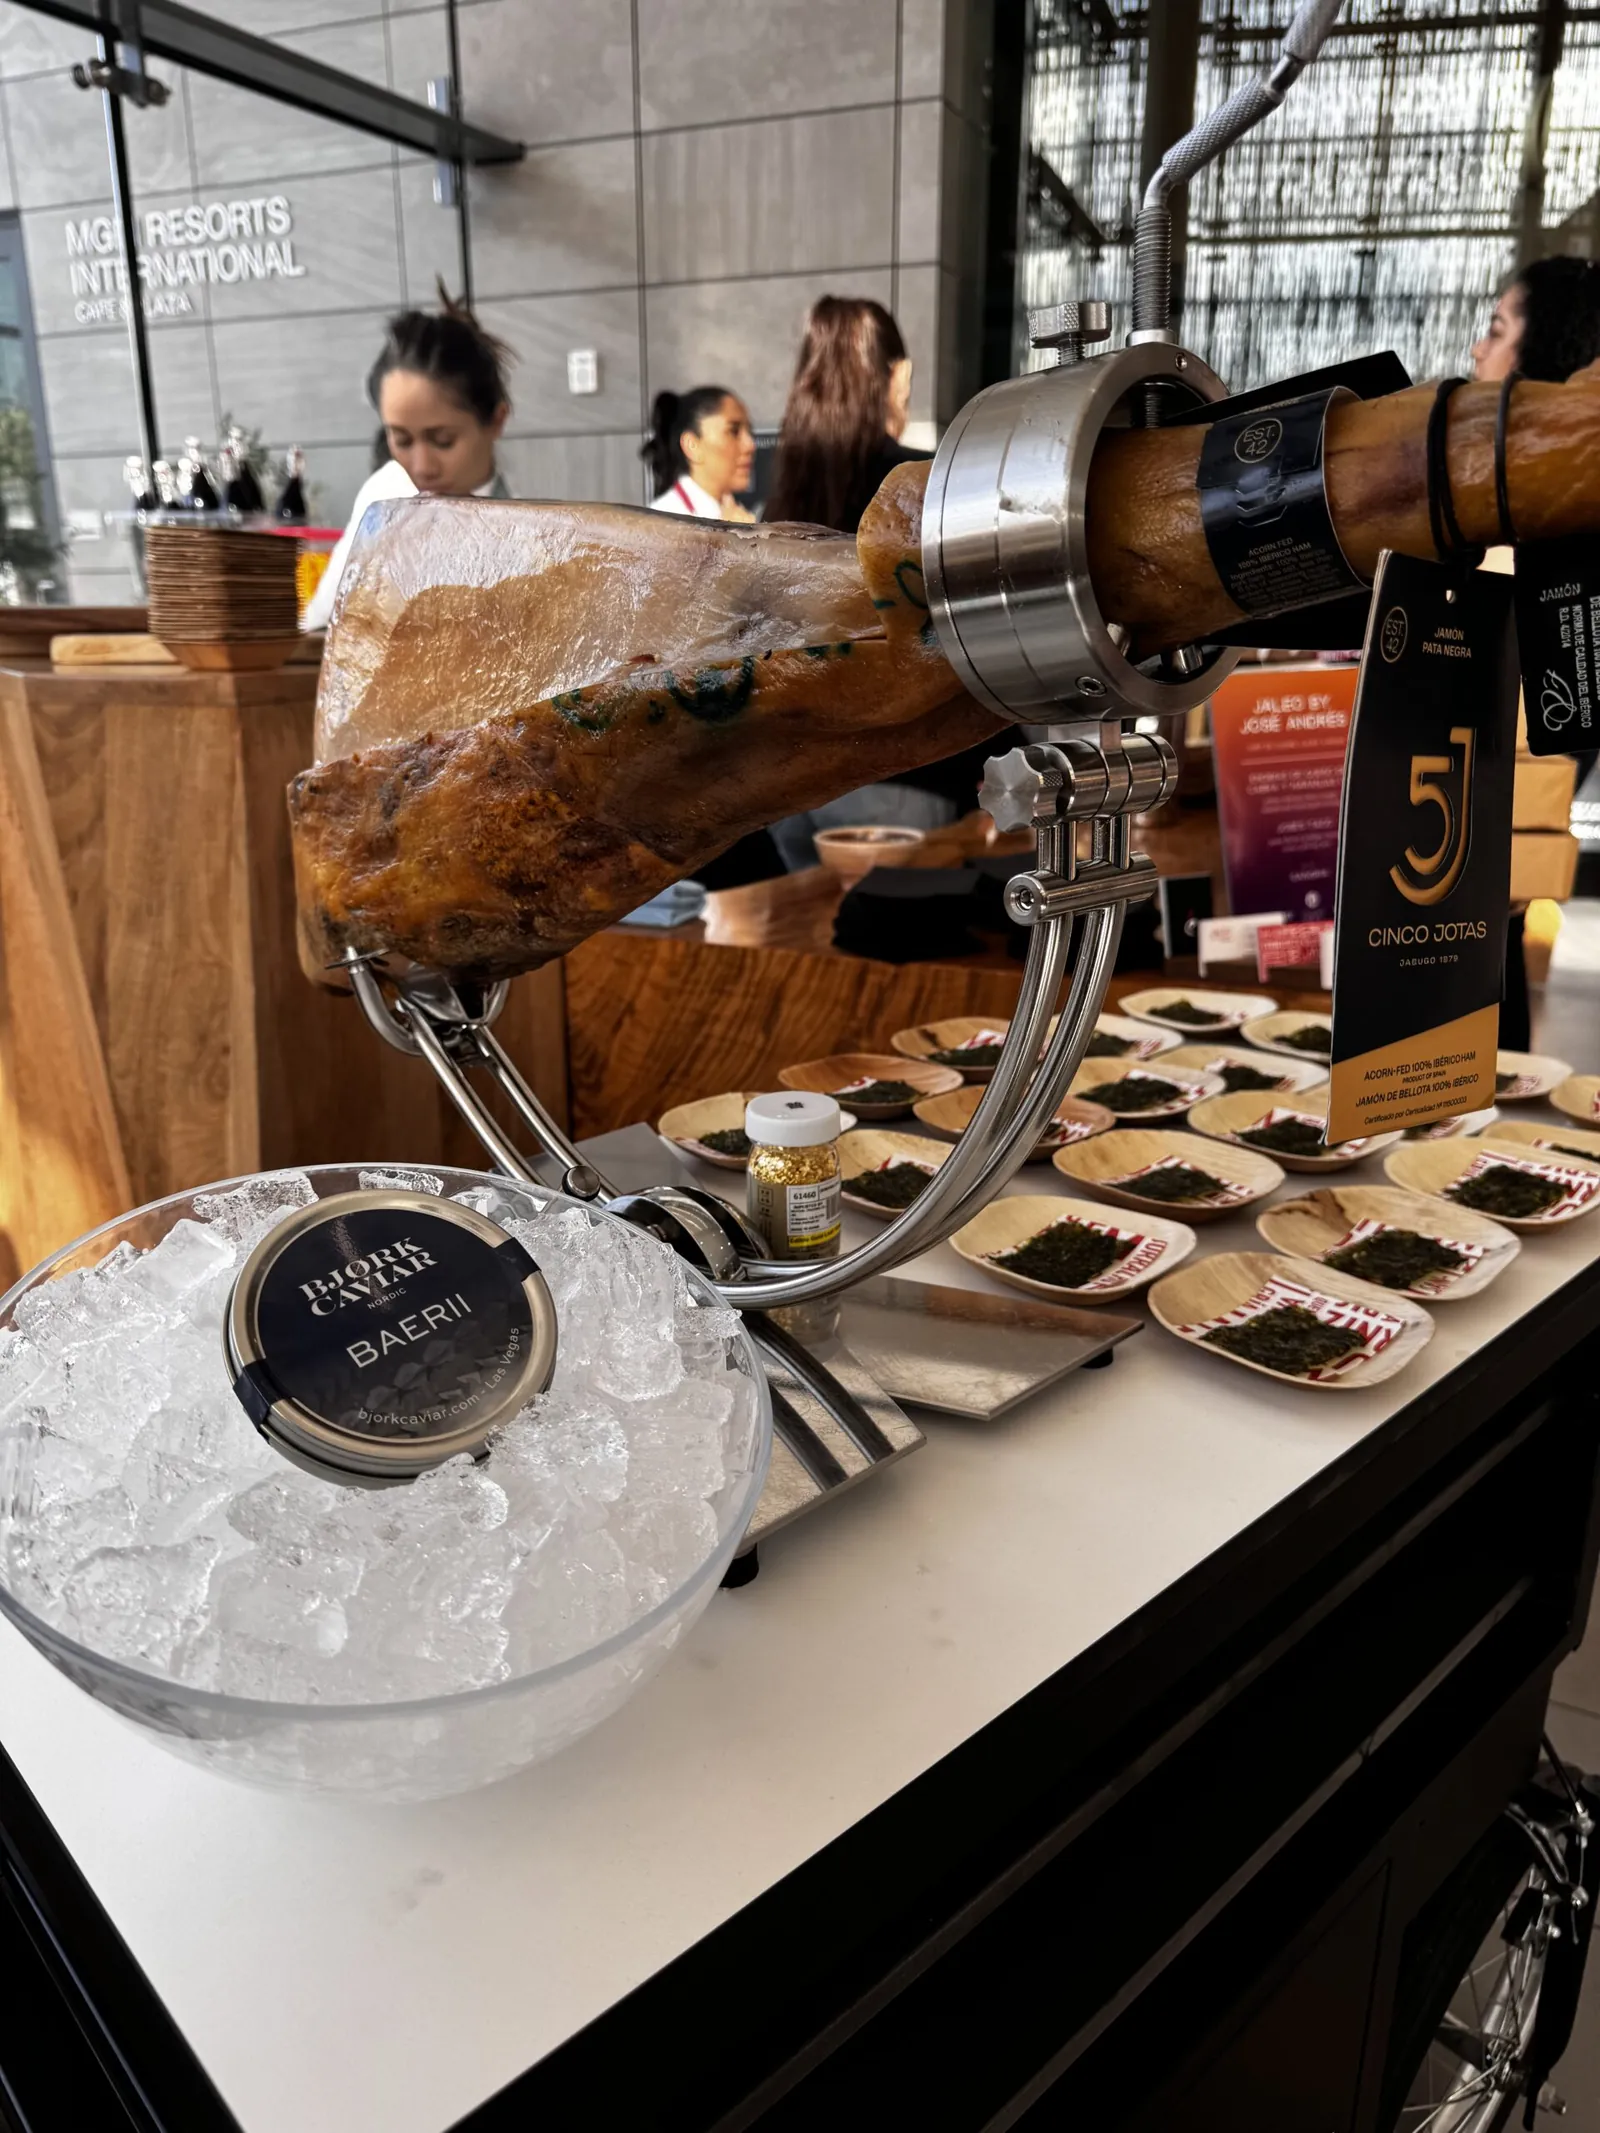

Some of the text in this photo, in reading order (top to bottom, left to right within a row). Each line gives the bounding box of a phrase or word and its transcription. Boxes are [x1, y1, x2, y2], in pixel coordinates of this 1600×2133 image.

[145, 195, 293, 249] RESORTS
[1243, 424, 1276, 442] EST.
[1245, 440, 1268, 456] 42
[1539, 582, 1581, 602] JAMÓN
[1385, 619, 1405, 637] EST.
[1434, 626, 1465, 640] JAMÓN
[1385, 637, 1400, 654] 42
[1574, 634, 1585, 646] DE
[1422, 641, 1472, 658] PATA NEGRA
[1577, 681, 1589, 697] DEL
[1579, 697, 1593, 728] IBÉRICO
[1368, 920, 1487, 947] CINCO JOTAS
[1399, 956, 1436, 967] JABUGO
[1364, 1050, 1476, 1081] ACORN-FED 100% IBÉRICO HAM
[1402, 1070, 1447, 1084] PRODUCT OF SPAIN
[1355, 1073, 1479, 1108] JAMÓN DE BELLOTA 100% IBÉRICO
[1394, 1110, 1405, 1120] por
[793, 1190, 817, 1200] 61460
[311, 1251, 438, 1316] CAVIAR
[366, 1287, 407, 1310] NORDIC
[346, 1293, 472, 1368] BAERII
[358, 1393, 480, 1425] bjorkcaviar.com
[485, 1367, 506, 1389] Las
[499, 1327, 520, 1365] Vegas
